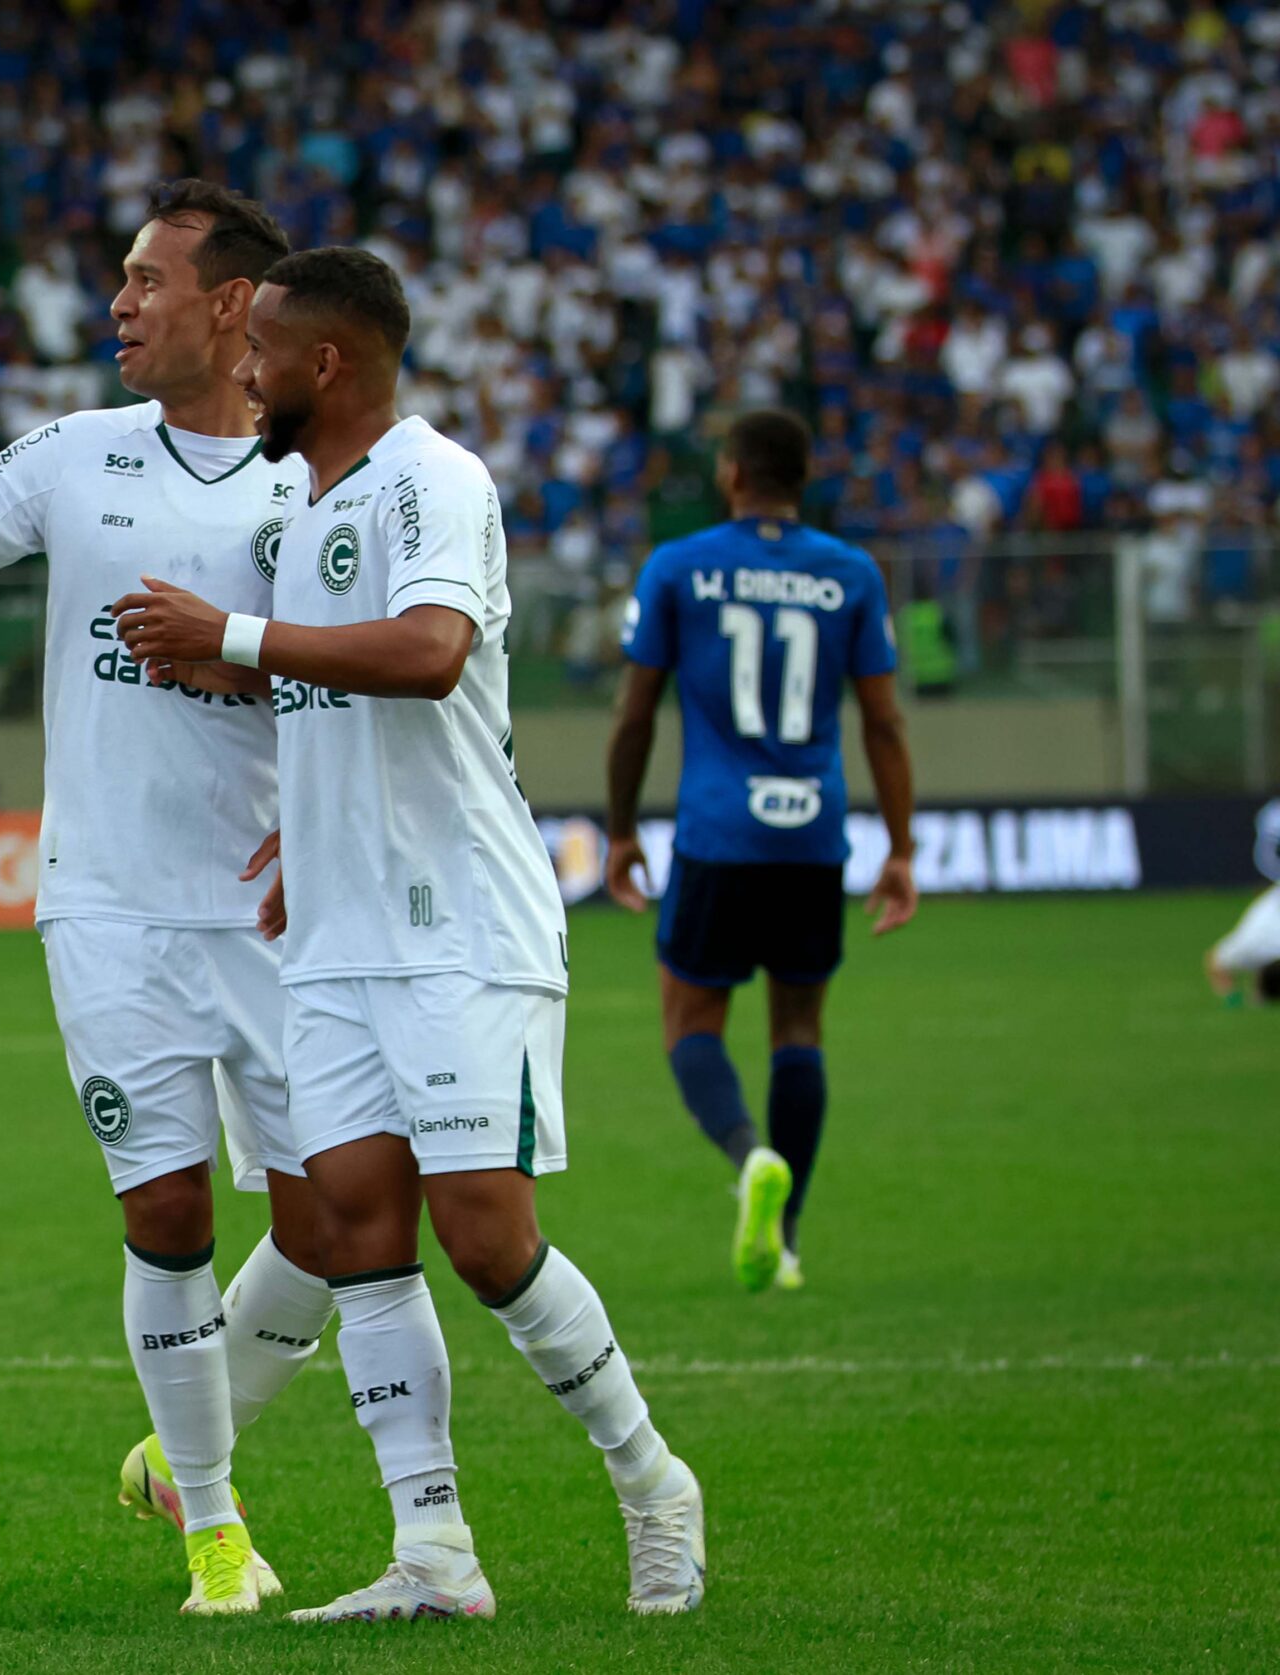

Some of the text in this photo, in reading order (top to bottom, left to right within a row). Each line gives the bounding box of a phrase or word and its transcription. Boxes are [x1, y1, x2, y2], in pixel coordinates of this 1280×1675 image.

[101, 513, 135, 529] GREEN
[394, 476, 421, 561] HEBRON
[733, 567, 845, 612] RIBEIRO
[720, 603, 819, 745] 11
[418, 1115, 489, 1133] Sankhya
[142, 1312, 227, 1350] GREEN
[351, 1380, 412, 1408] EEN
[413, 1493, 459, 1508] SPORT
